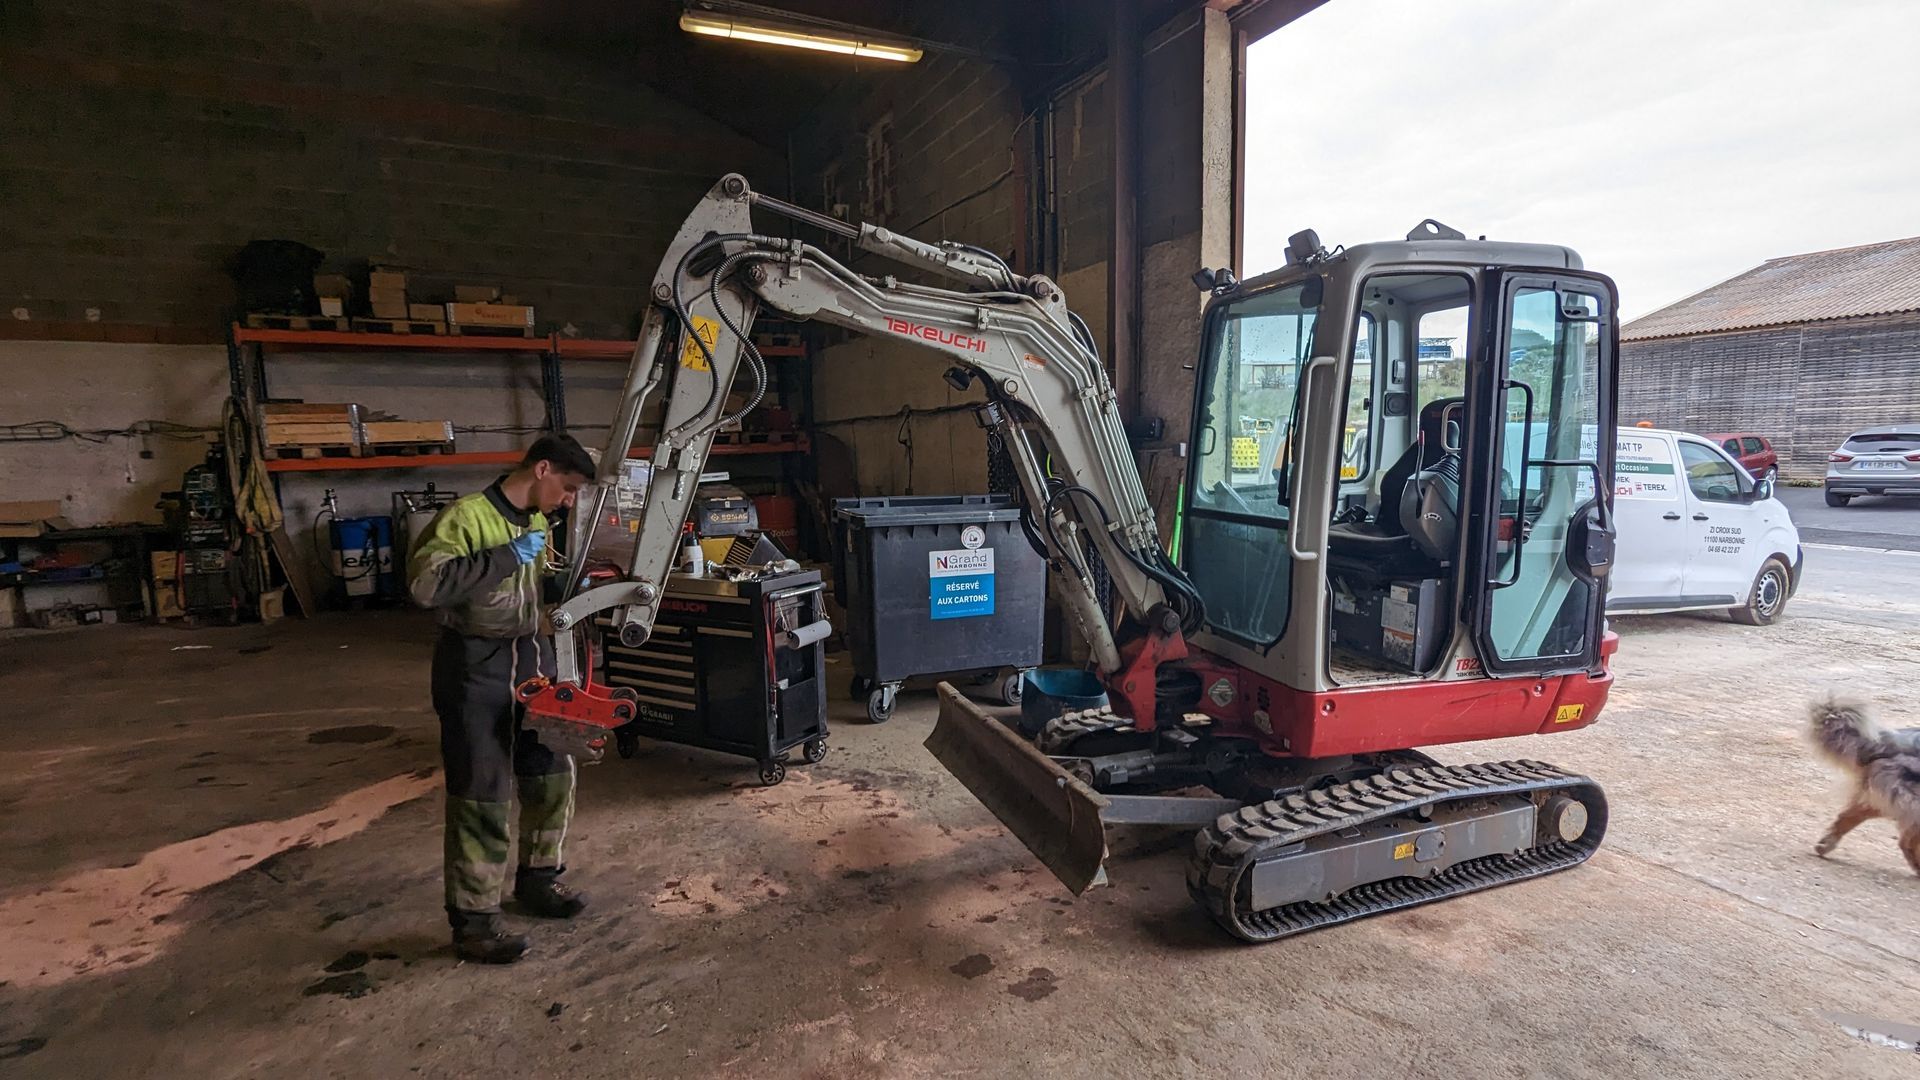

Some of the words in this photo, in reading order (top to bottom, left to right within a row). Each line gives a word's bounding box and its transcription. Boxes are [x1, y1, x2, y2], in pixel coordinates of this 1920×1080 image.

[1632, 443, 1643, 452] TP
[1621, 464, 1649, 472] Occasion
[1643, 483, 1666, 491] TEREX
[1716, 526, 1730, 534] CROIX
[1719, 536, 1745, 544] NARBONNE
[949, 553, 987, 564] Grand
[945, 579, 980, 592] RÉSERVÉ
[937, 596, 953, 605] AUX
[954, 594, 989, 604] CARTONS
[1456, 657, 1480, 671] TB2
